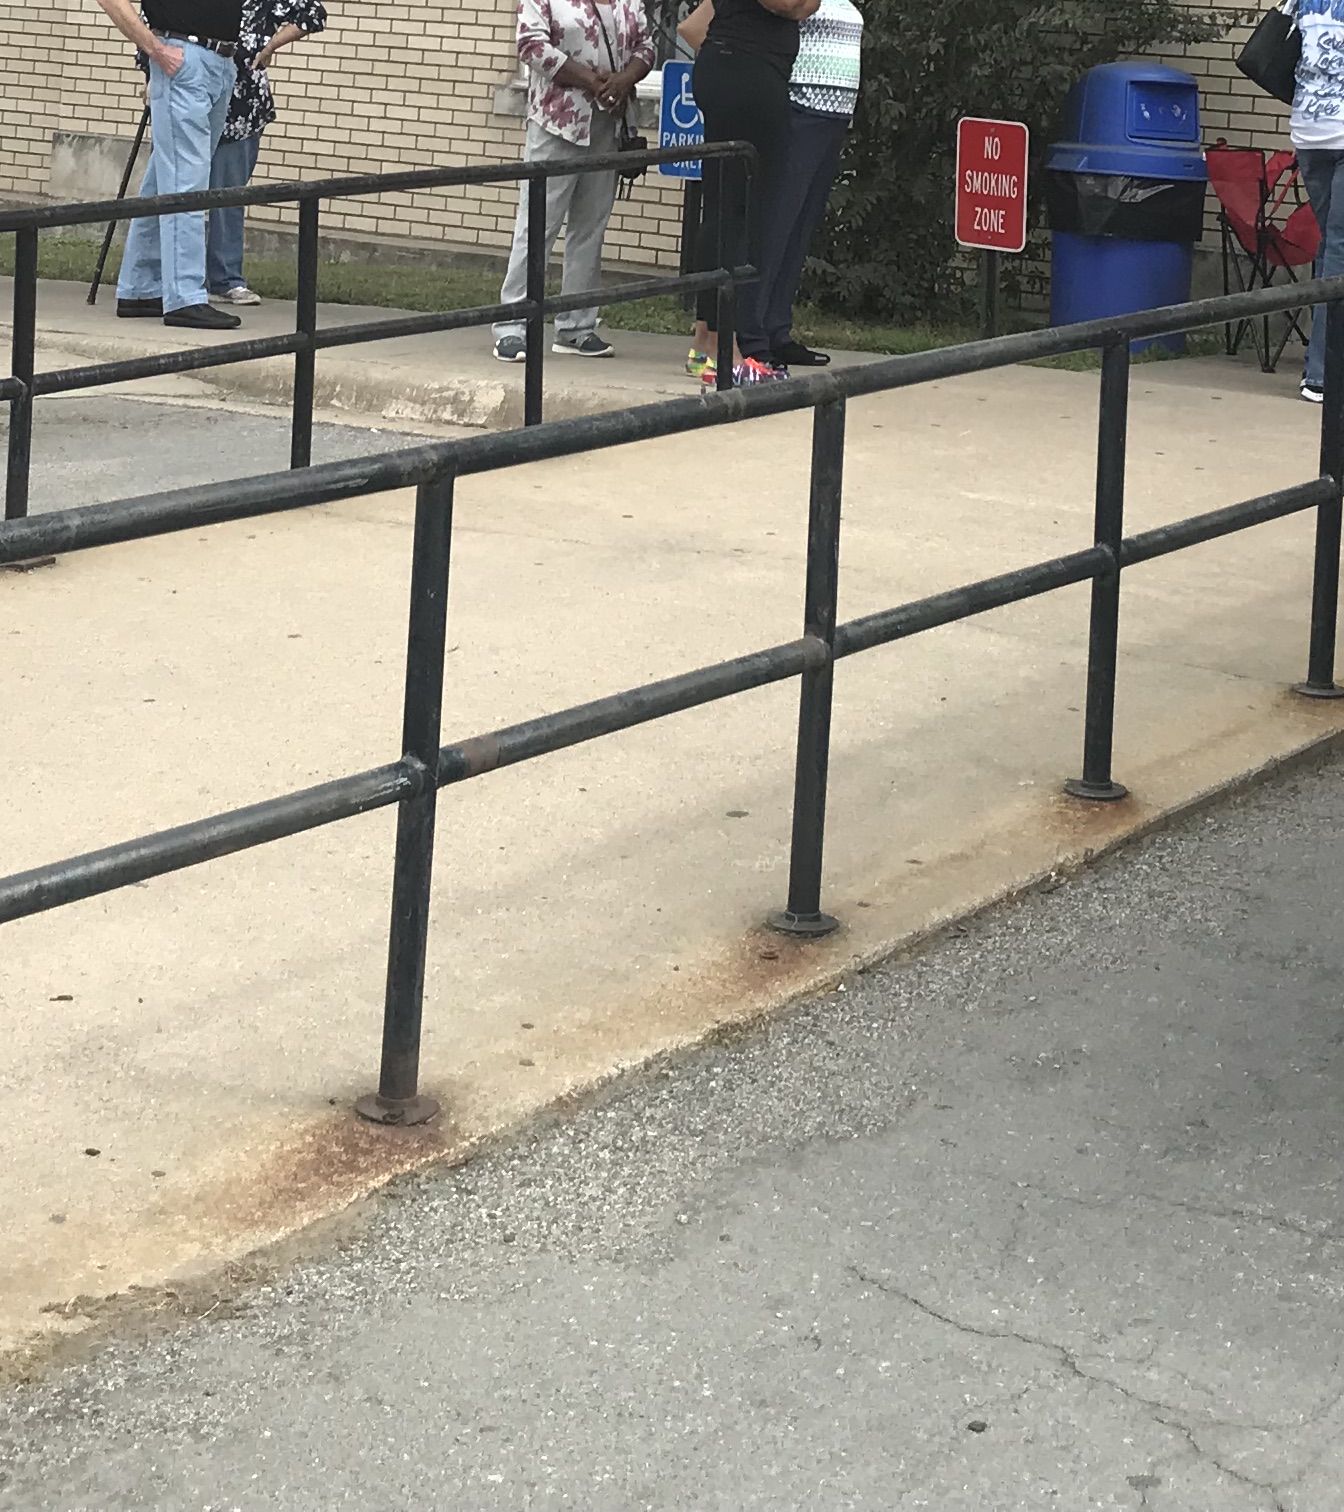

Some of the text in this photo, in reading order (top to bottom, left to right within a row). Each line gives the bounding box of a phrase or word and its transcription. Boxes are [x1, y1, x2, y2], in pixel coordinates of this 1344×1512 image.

[662, 131, 705, 147] PARKIN
[984, 136, 1000, 160] NO
[964, 170, 1017, 198] SMOKING
[973, 207, 1005, 233] ZONE
